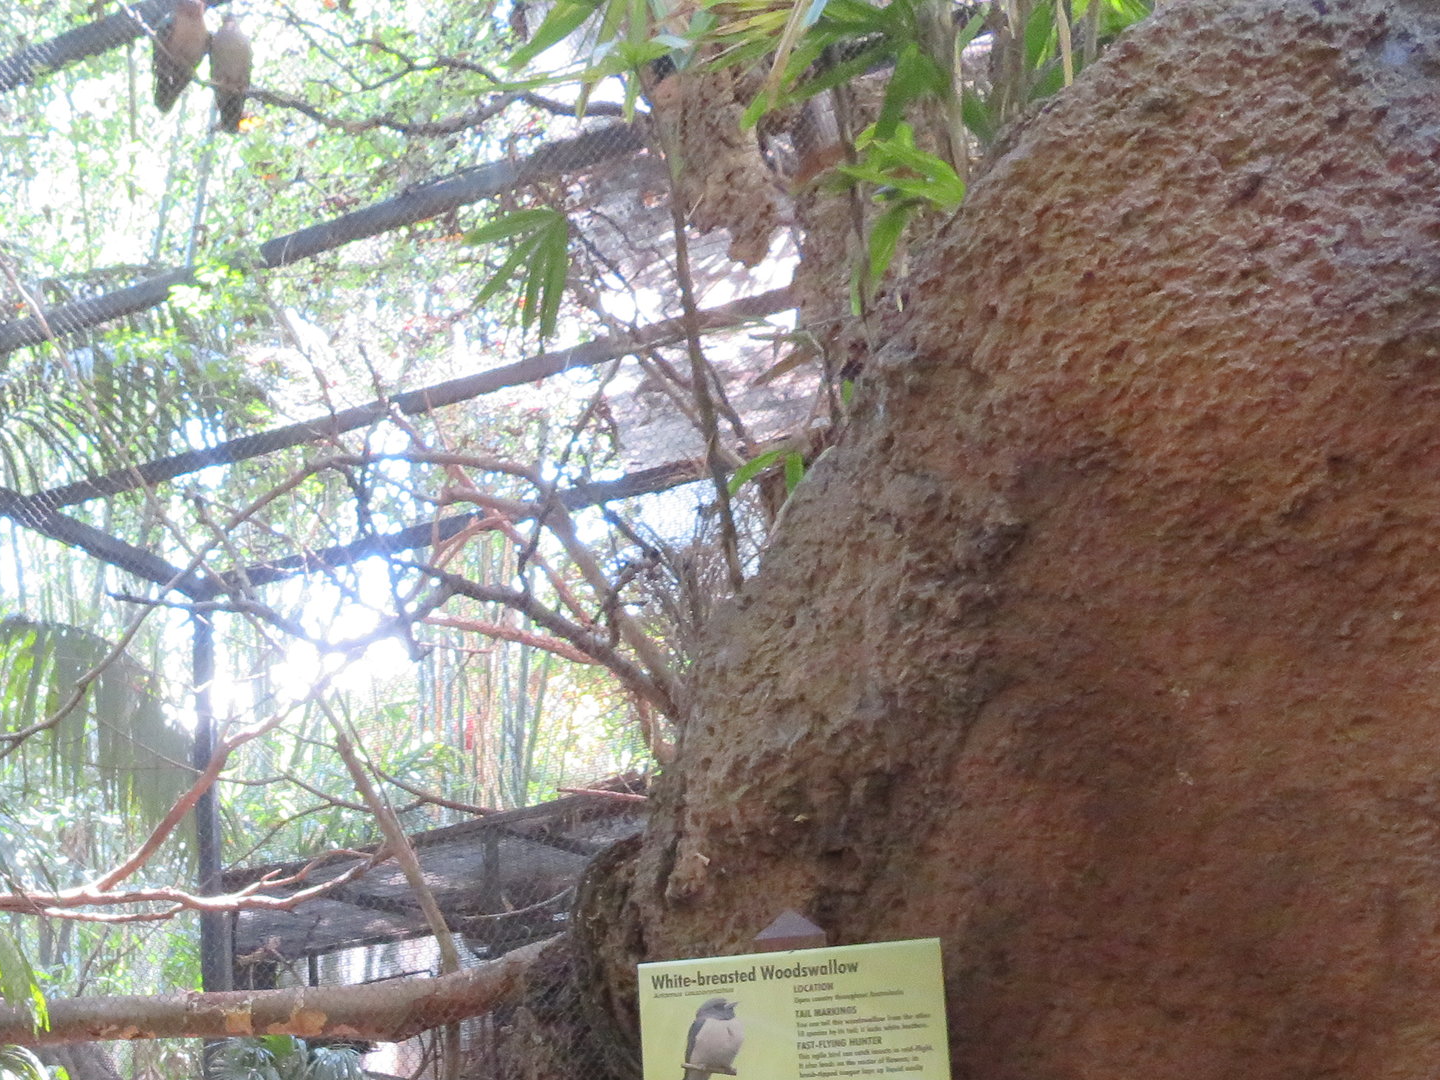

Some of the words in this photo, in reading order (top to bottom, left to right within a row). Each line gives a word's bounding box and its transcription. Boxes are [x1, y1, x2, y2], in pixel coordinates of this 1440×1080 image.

[651, 966, 755, 990] White-breasted
[760, 959, 859, 980] Woodswallow
[793, 982, 834, 993] LOCATION
[795, 1010, 812, 1018] TAIL
[814, 1006, 857, 1017] MARKINGS
[797, 1038, 847, 1050] FAST-FLYING
[849, 1036, 882, 1047] HUNTER
